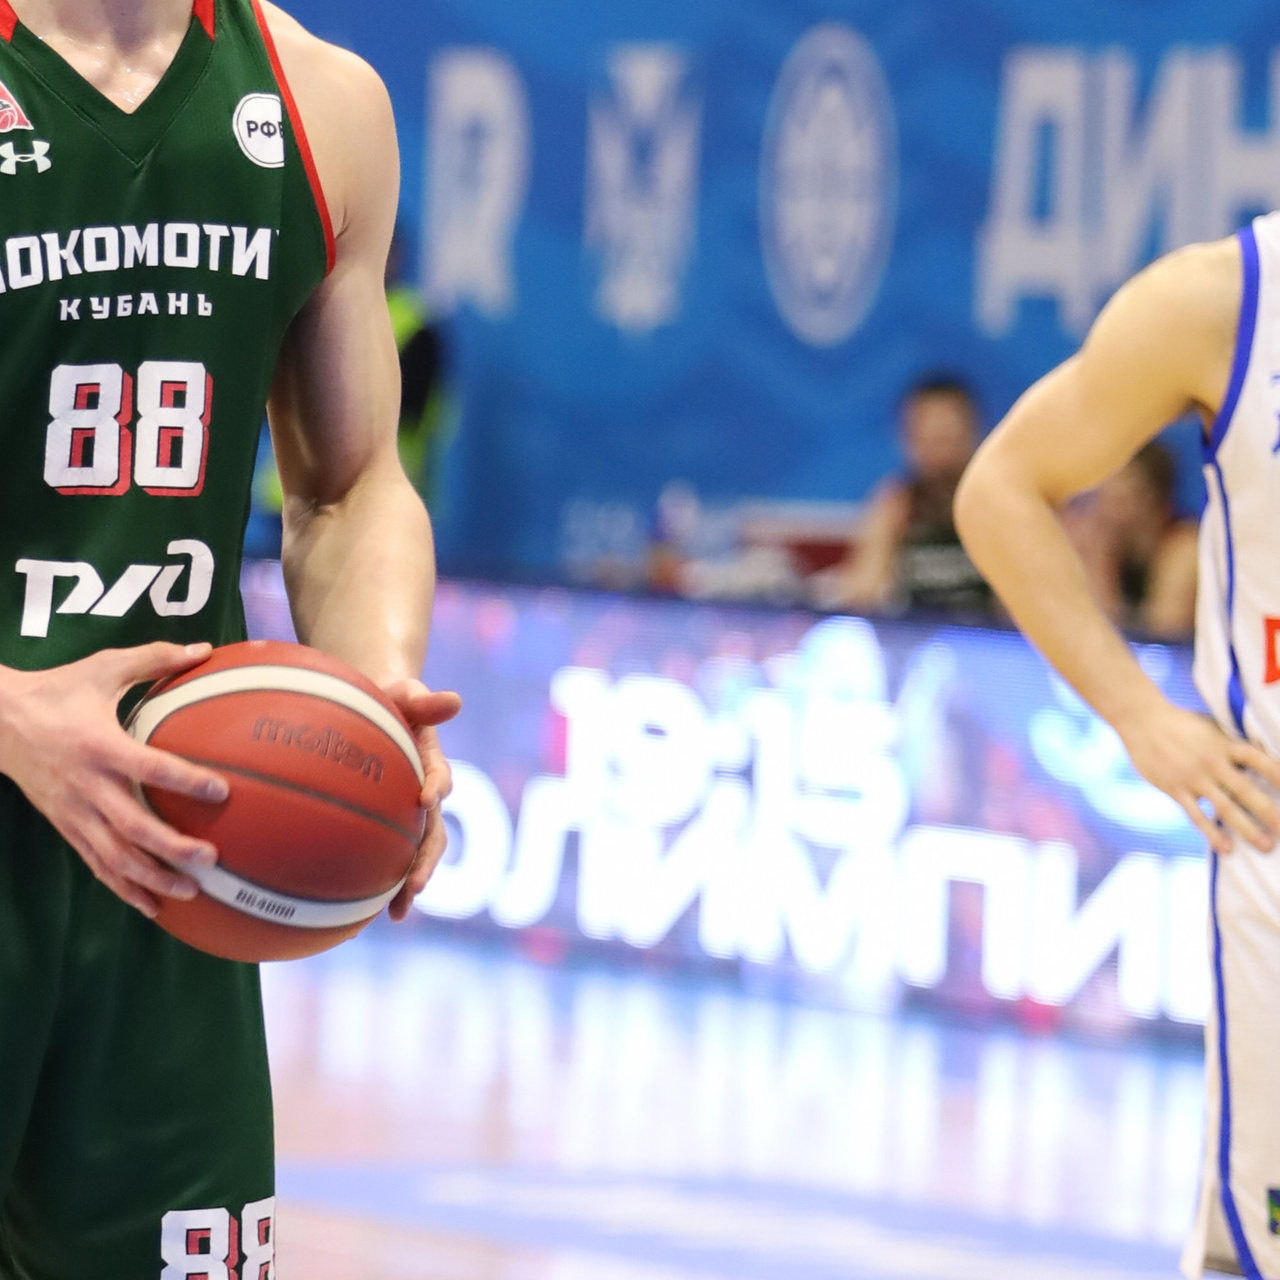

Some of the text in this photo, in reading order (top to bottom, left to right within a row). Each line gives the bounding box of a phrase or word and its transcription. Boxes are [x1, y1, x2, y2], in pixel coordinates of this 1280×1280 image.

[60, 293, 213, 321] КУБАНЬ
[43, 361, 213, 496] 88
[252, 717, 384, 783] molten
